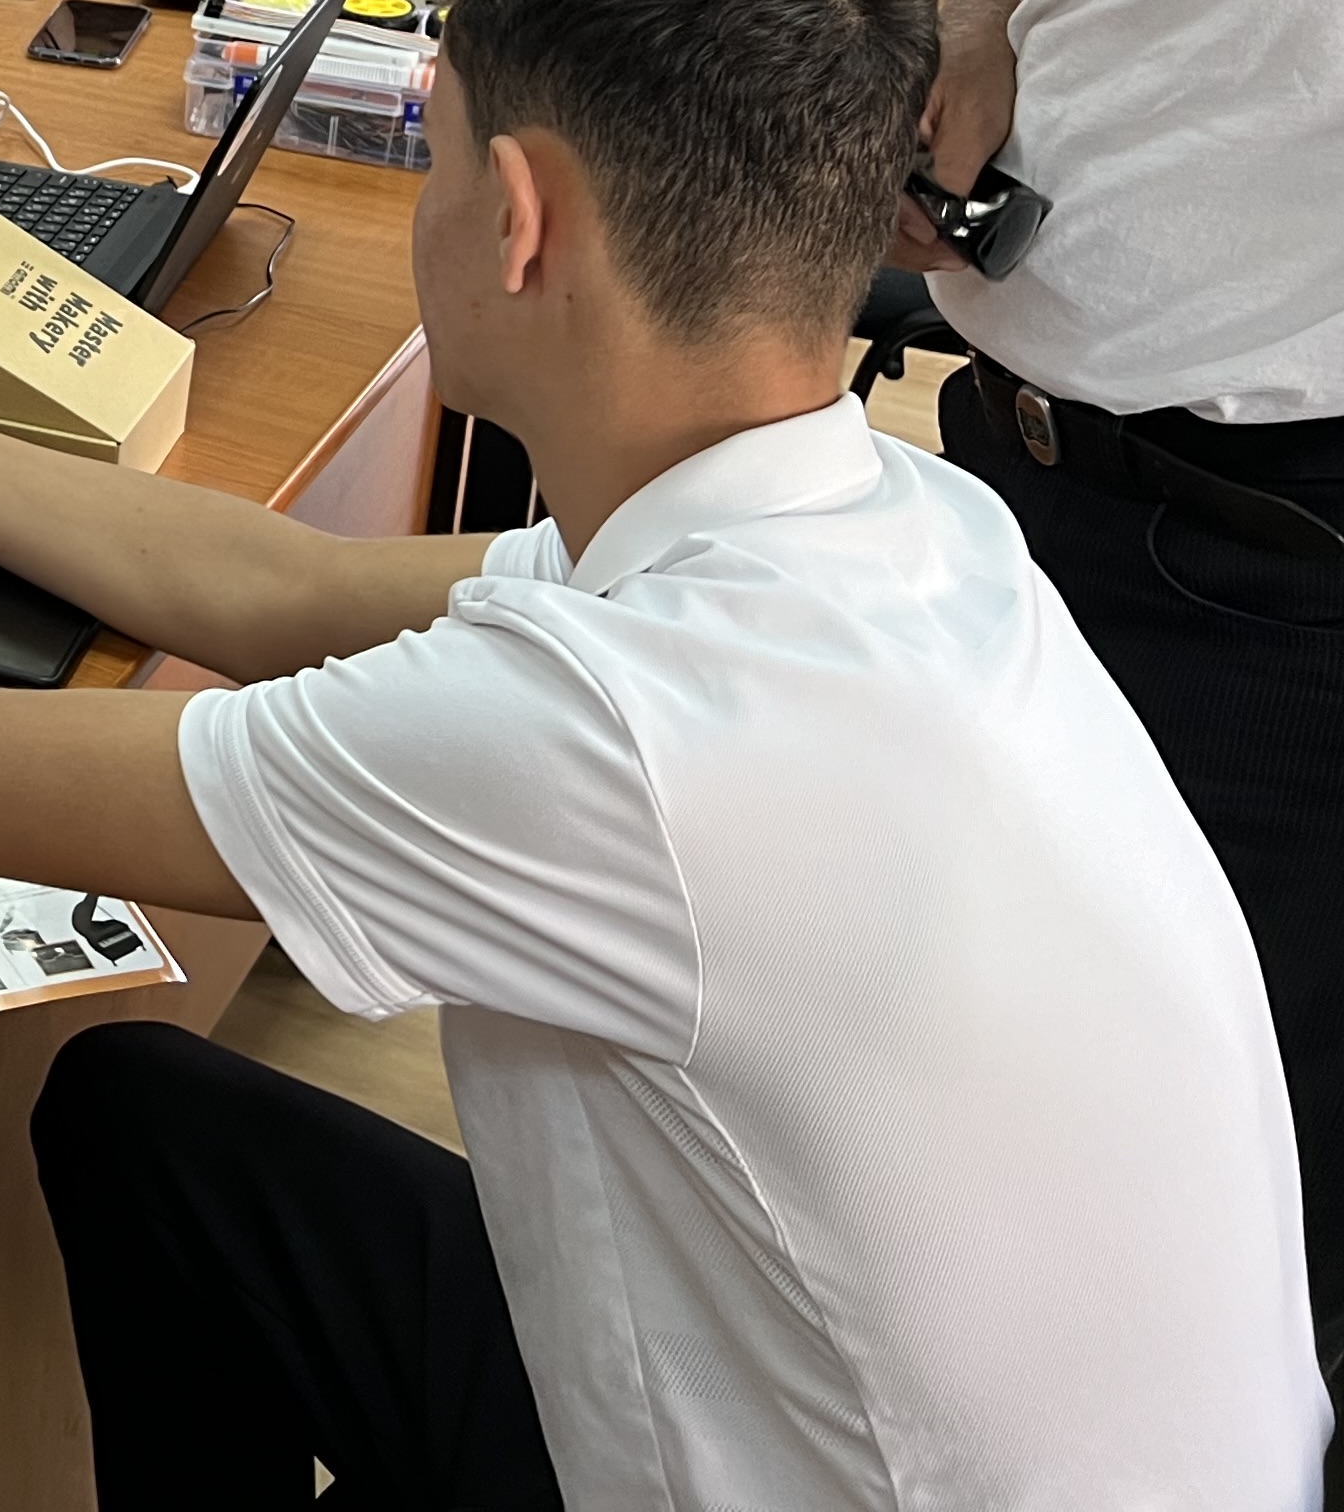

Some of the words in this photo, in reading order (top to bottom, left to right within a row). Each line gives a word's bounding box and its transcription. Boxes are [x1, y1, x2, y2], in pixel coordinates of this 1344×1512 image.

[18, 273, 59, 313] with
[29, 292, 96, 355] Makery
[68, 311, 124, 368] Master
